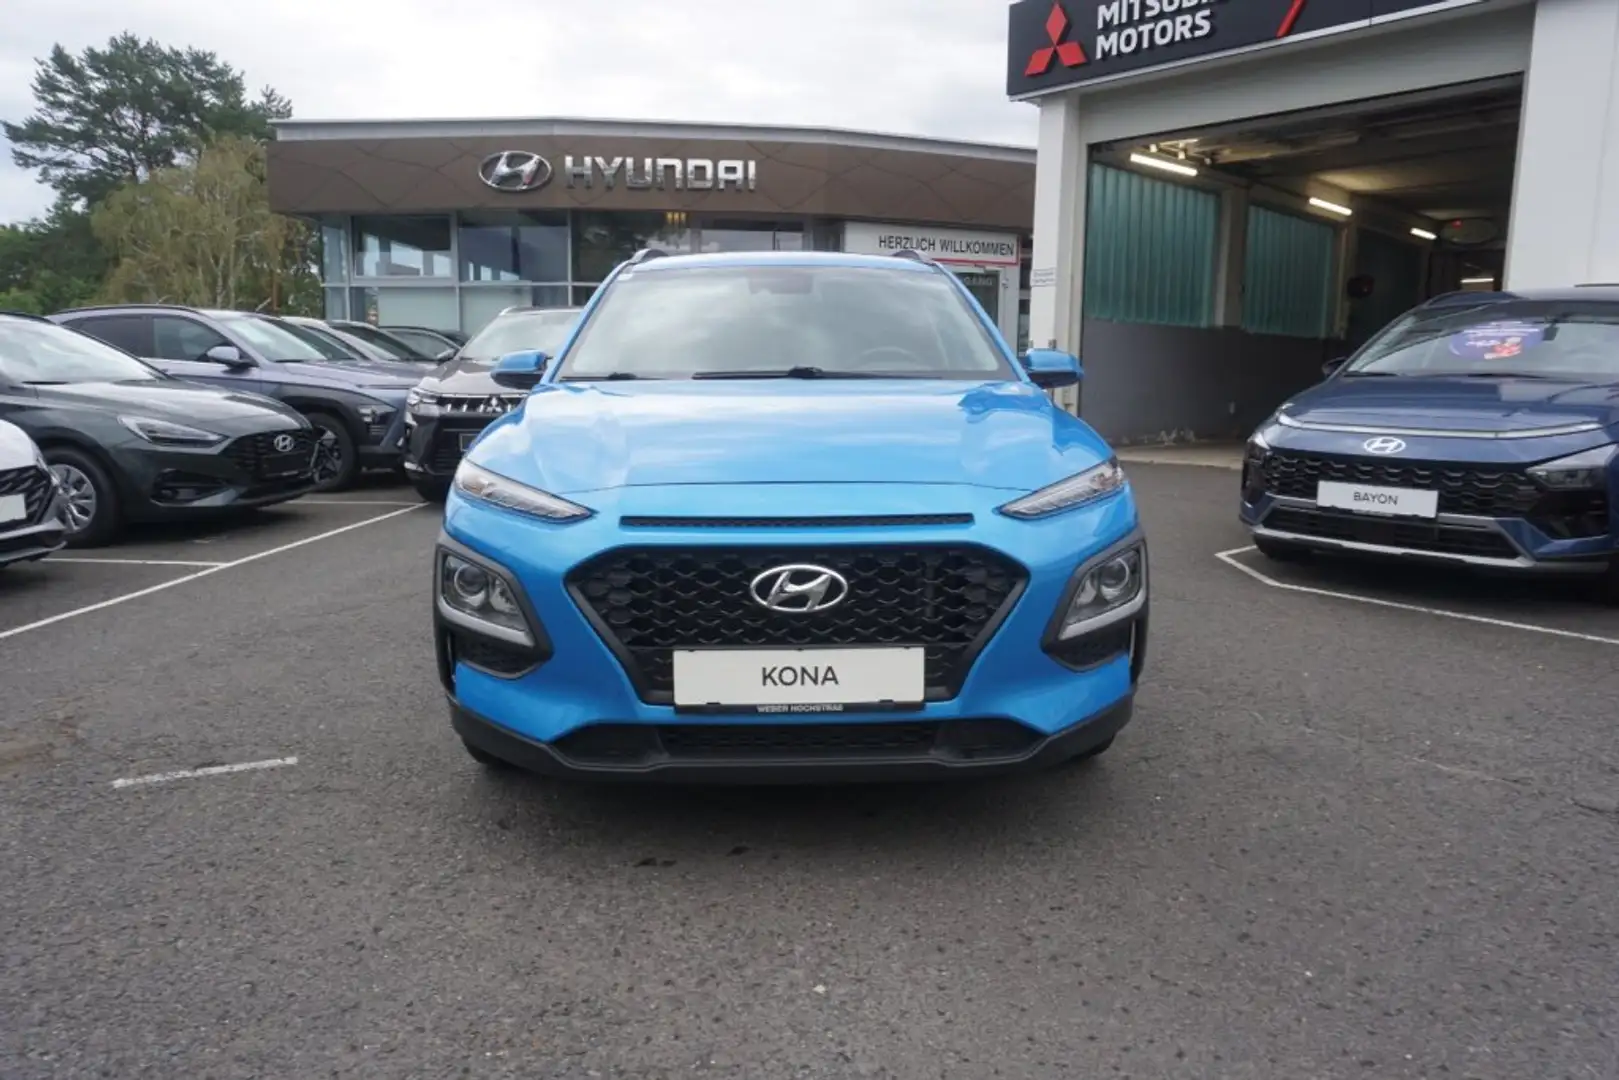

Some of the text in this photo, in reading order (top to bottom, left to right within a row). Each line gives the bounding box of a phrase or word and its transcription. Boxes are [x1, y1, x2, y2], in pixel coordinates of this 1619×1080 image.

[1096, 9, 1212, 60] MOTORS
[564, 155, 756, 191] HYUNDAI
[878, 235, 1015, 257] HERZLICH WILLKOMMEN
[1353, 491, 1399, 506] BAYON
[761, 665, 840, 687] KONA
